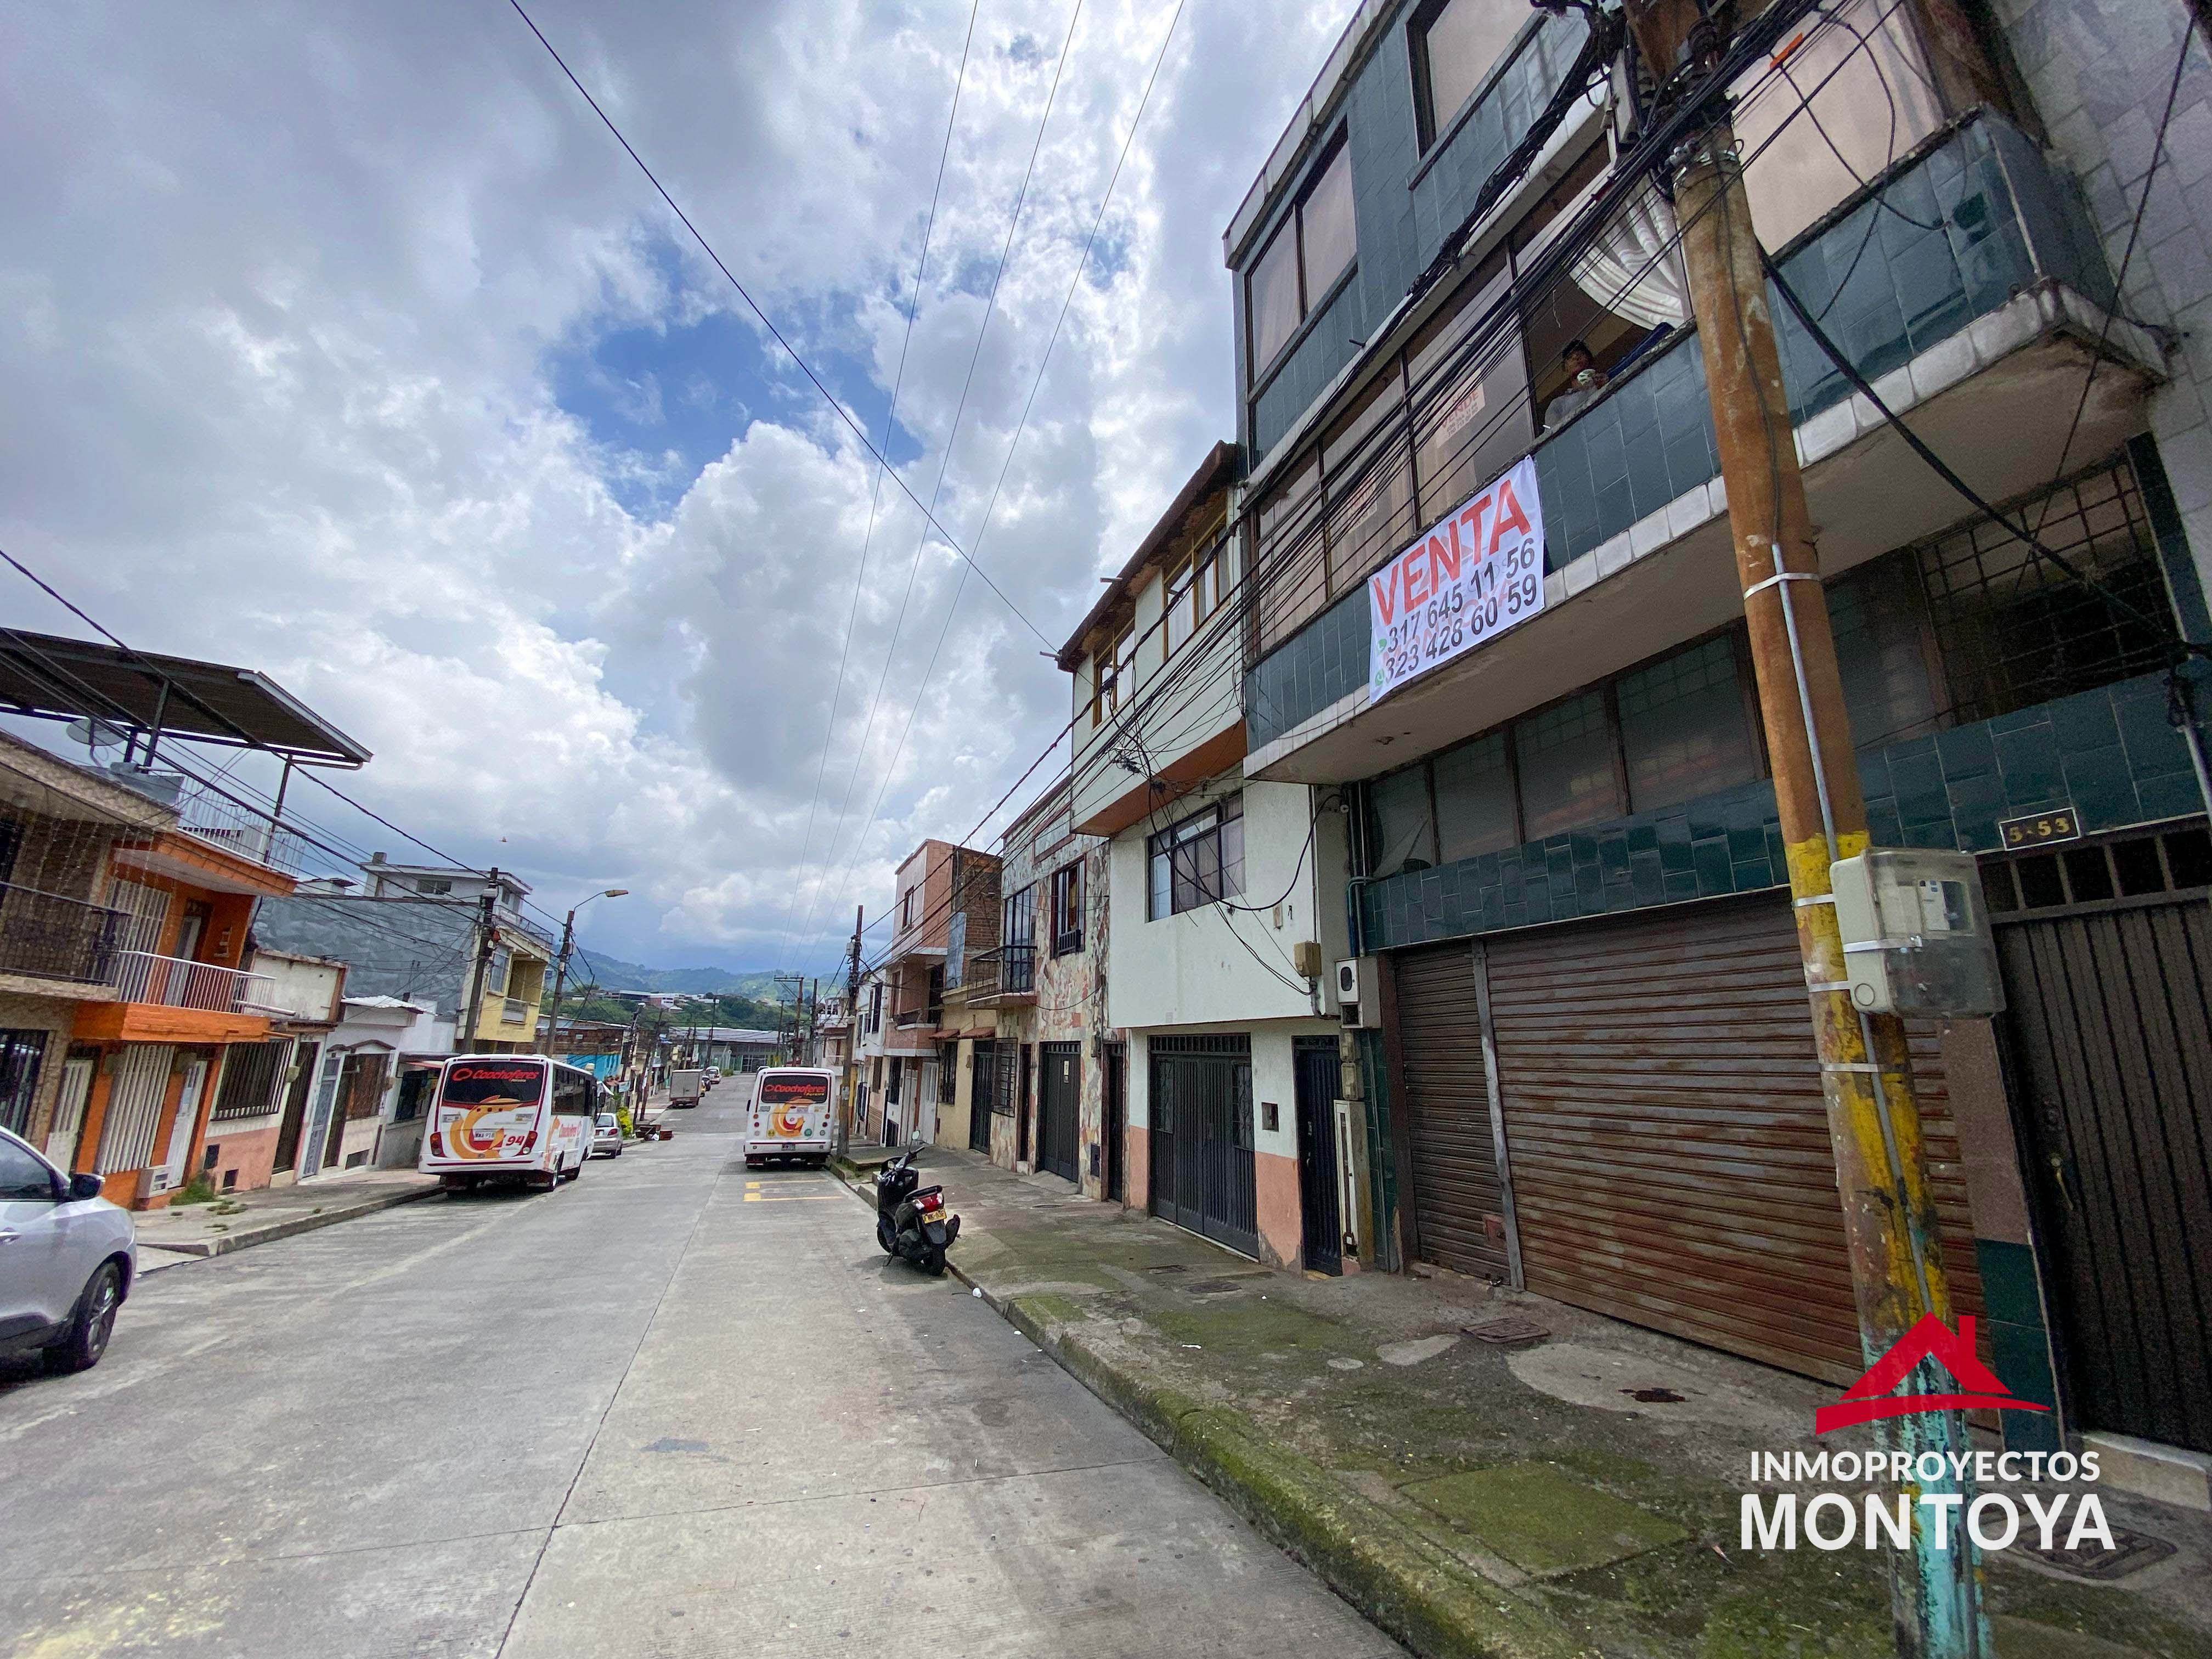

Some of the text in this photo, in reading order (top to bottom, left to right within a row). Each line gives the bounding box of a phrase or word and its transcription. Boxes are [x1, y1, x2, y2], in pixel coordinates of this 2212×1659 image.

[1373, 479, 1532, 627] VENTA
[1387, 610, 1420, 653] 317
[1427, 582, 1463, 629] 645
[1471, 561, 1495, 600] 11
[1506, 537, 1534, 579] 56
[1385, 644, 1419, 684] 323
[1426, 618, 1463, 660] 428
[1471, 596, 1498, 635] 60
[1508, 573, 1537, 615] 59
[505, 1136, 525, 1146] 94
